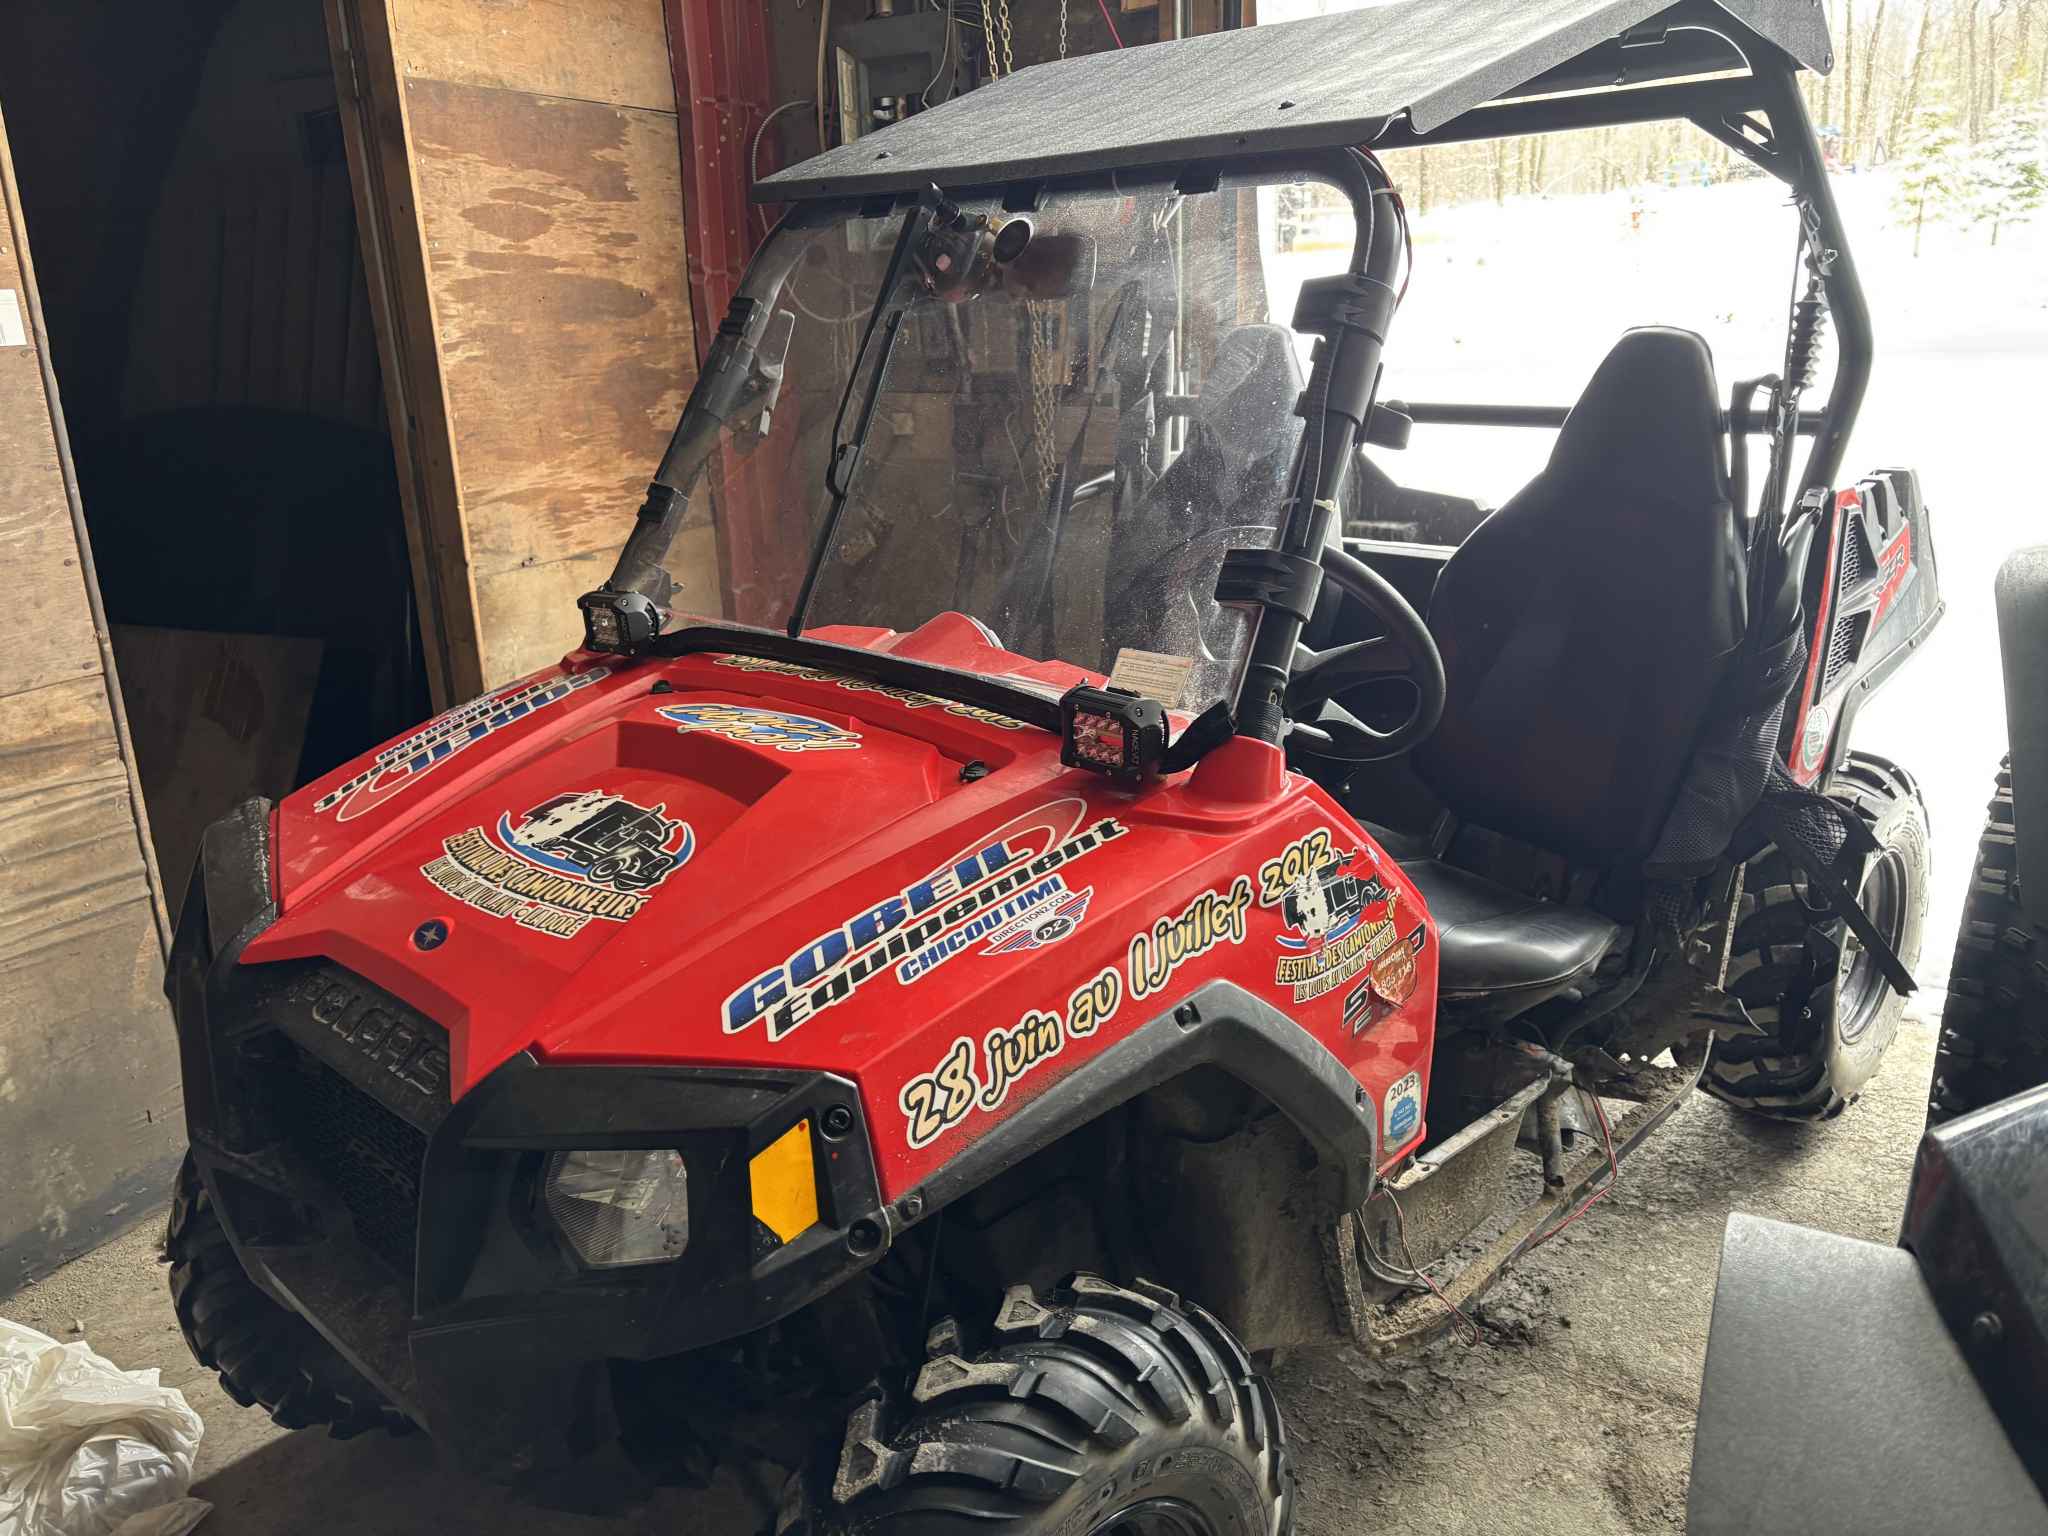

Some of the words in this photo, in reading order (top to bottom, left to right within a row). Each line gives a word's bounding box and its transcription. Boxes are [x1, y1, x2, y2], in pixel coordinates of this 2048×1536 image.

[443, 826, 503, 876] FESTIVAL
[479, 853, 528, 886] DES
[463, 884, 522, 917] VOLANT
[502, 866, 651, 920] CAMIONNEURS
[722, 840, 1034, 1033] GOBEIL
[768, 818, 1129, 1041] Equipement
[898, 875, 1068, 982] CHICOUTIMI
[1324, 942, 1345, 971] DES
[903, 1039, 977, 1145] 28
[980, 1012, 1061, 1107] juin
[1070, 968, 1119, 1036] au
[1150, 878, 1251, 988] juillet
[1260, 830, 1332, 906] 2012
[1390, 1073, 1416, 1102] 2023
